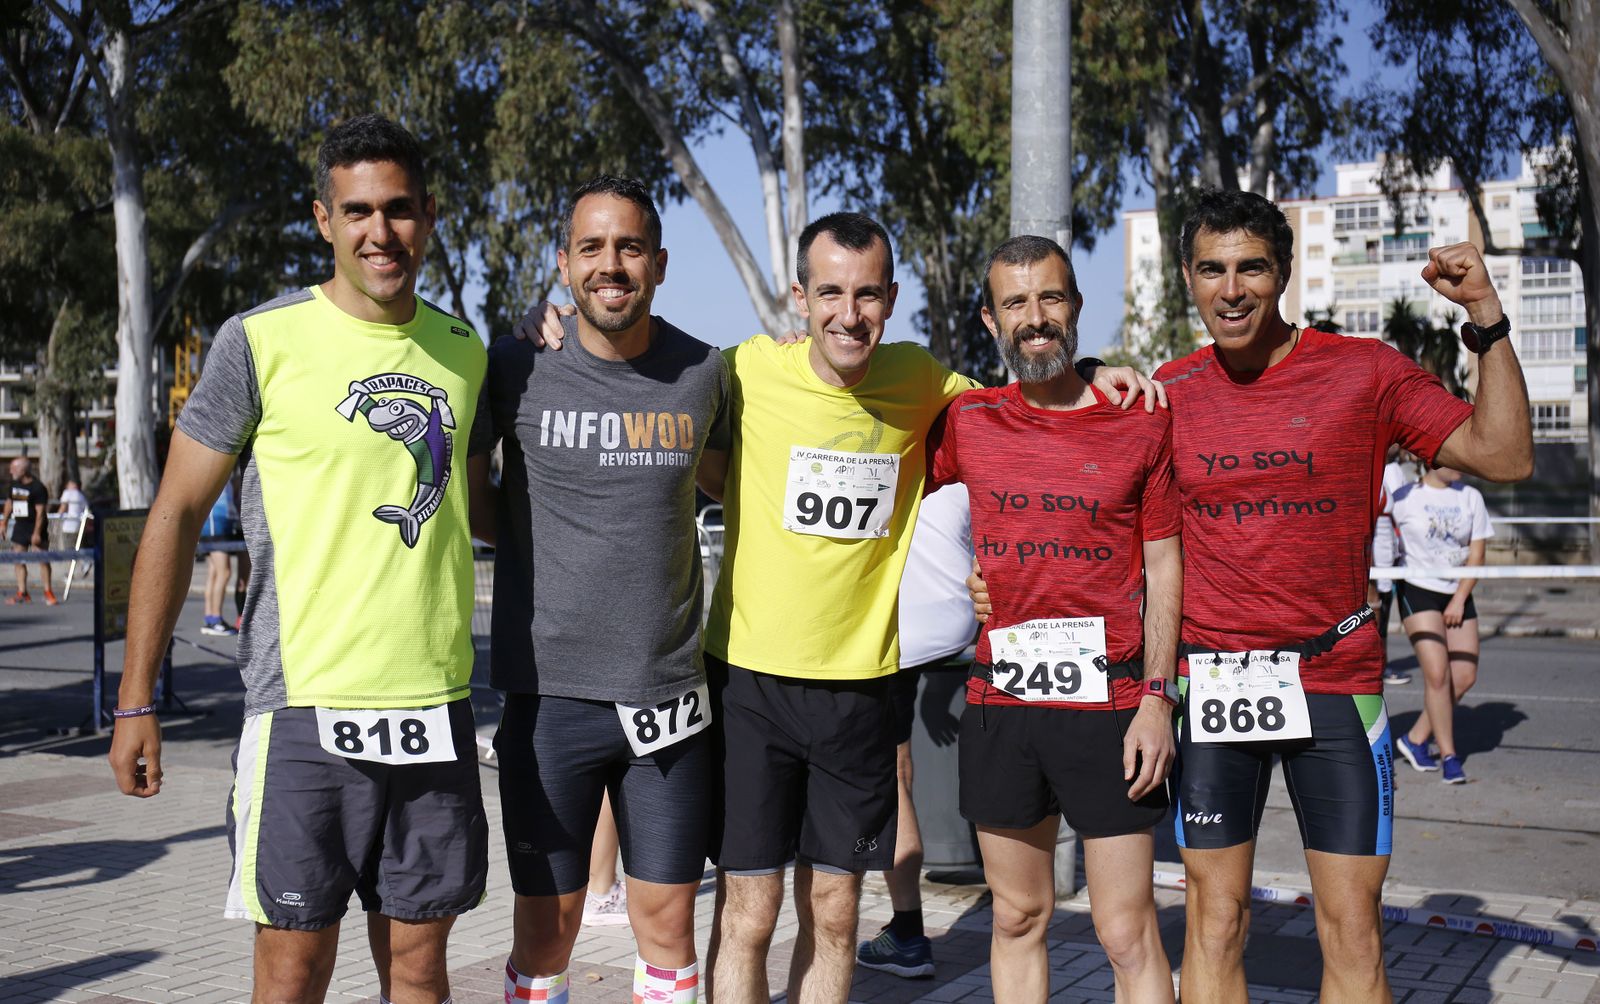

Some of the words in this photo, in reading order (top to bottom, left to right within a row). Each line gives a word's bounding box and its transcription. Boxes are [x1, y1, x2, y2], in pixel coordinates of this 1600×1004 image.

[368, 377, 428, 393] RAPACES
[540, 410, 694, 449] INFOWOD
[600, 452, 652, 466] REVISTA
[806, 452, 845, 464] CARRERA
[869, 458, 894, 466] PRENSA
[1252, 450, 1313, 475] soy
[796, 492, 878, 530] 907
[1041, 493, 1099, 523] soy
[1192, 498, 1222, 519] tu
[1233, 496, 1337, 525] primo
[978, 535, 1008, 556] tu
[1016, 538, 1112, 564] primo
[1062, 621, 1095, 629] PRENSA
[1204, 657, 1238, 665] CARERA
[1260, 655, 1291, 663] PRSA
[1003, 661, 1082, 695] 249
[632, 690, 703, 744] 872
[1202, 696, 1286, 734] 868
[333, 718, 429, 756] 818
[1185, 812, 1223, 825] vive
